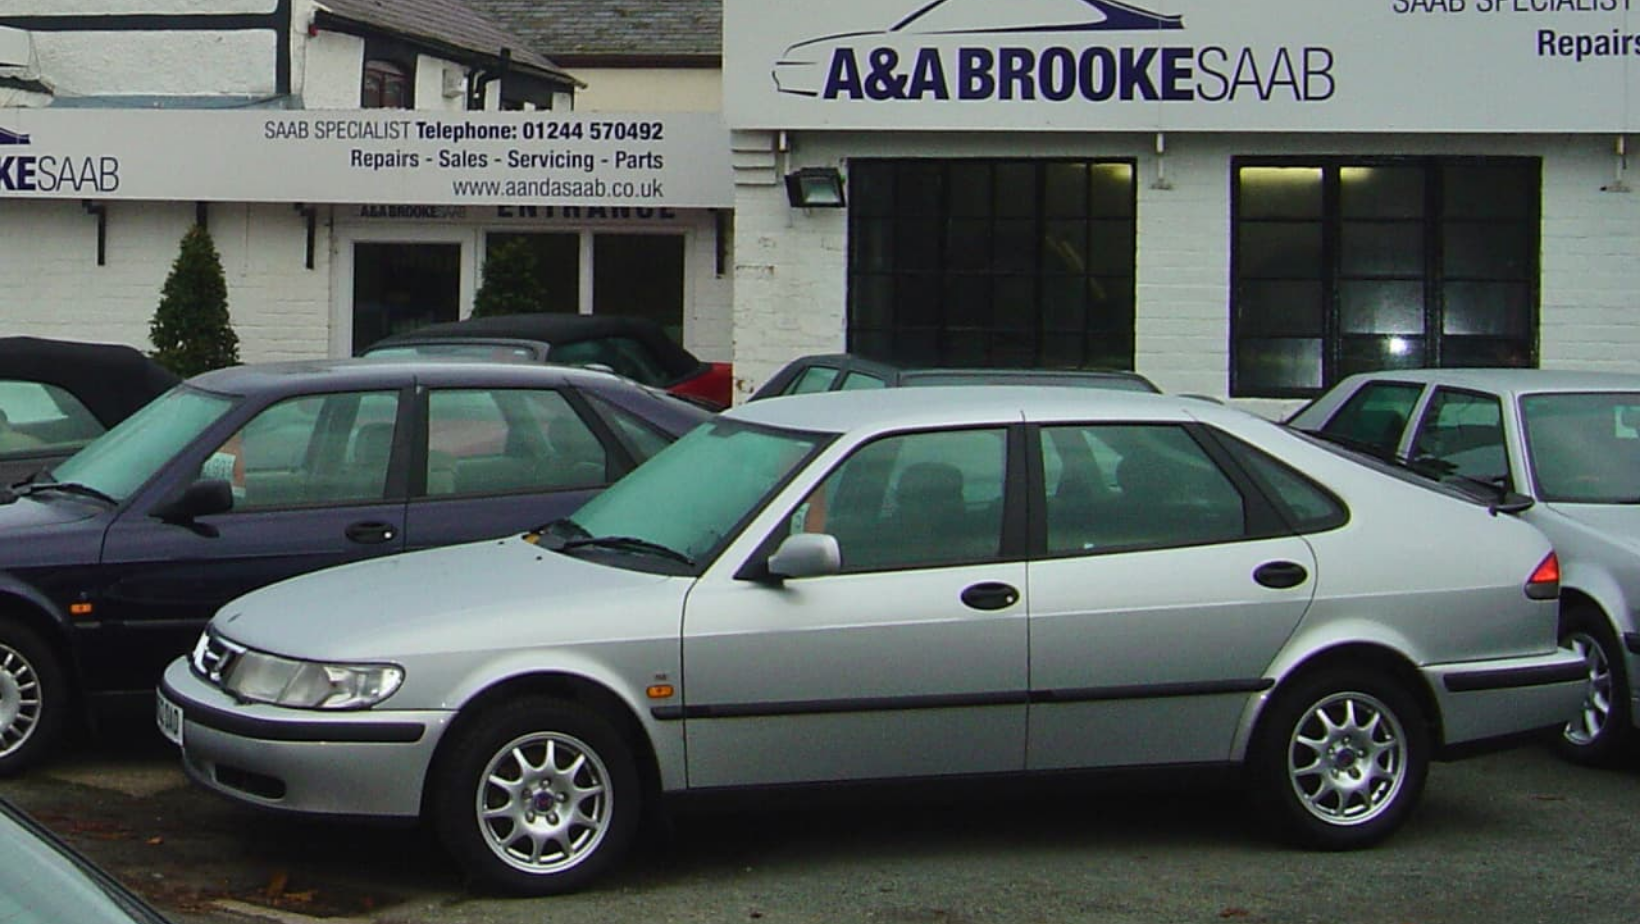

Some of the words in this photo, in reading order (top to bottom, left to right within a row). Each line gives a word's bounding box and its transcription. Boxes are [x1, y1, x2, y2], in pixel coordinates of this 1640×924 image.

[823, 47, 949, 100] A&A
[264, 121, 309, 139] SAAB
[314, 121, 411, 139] SPECIALIST
[416, 122, 517, 143] Telephone:
[523, 122, 583, 140] 01244
[590, 122, 664, 140] 570492
[351, 149, 419, 171] Repairs
[438, 150, 488, 168] Sales
[507, 150, 594, 172] Servicing
[615, 150, 664, 169] Parts
[453, 177, 664, 198] www.aandasaab.co.uk
